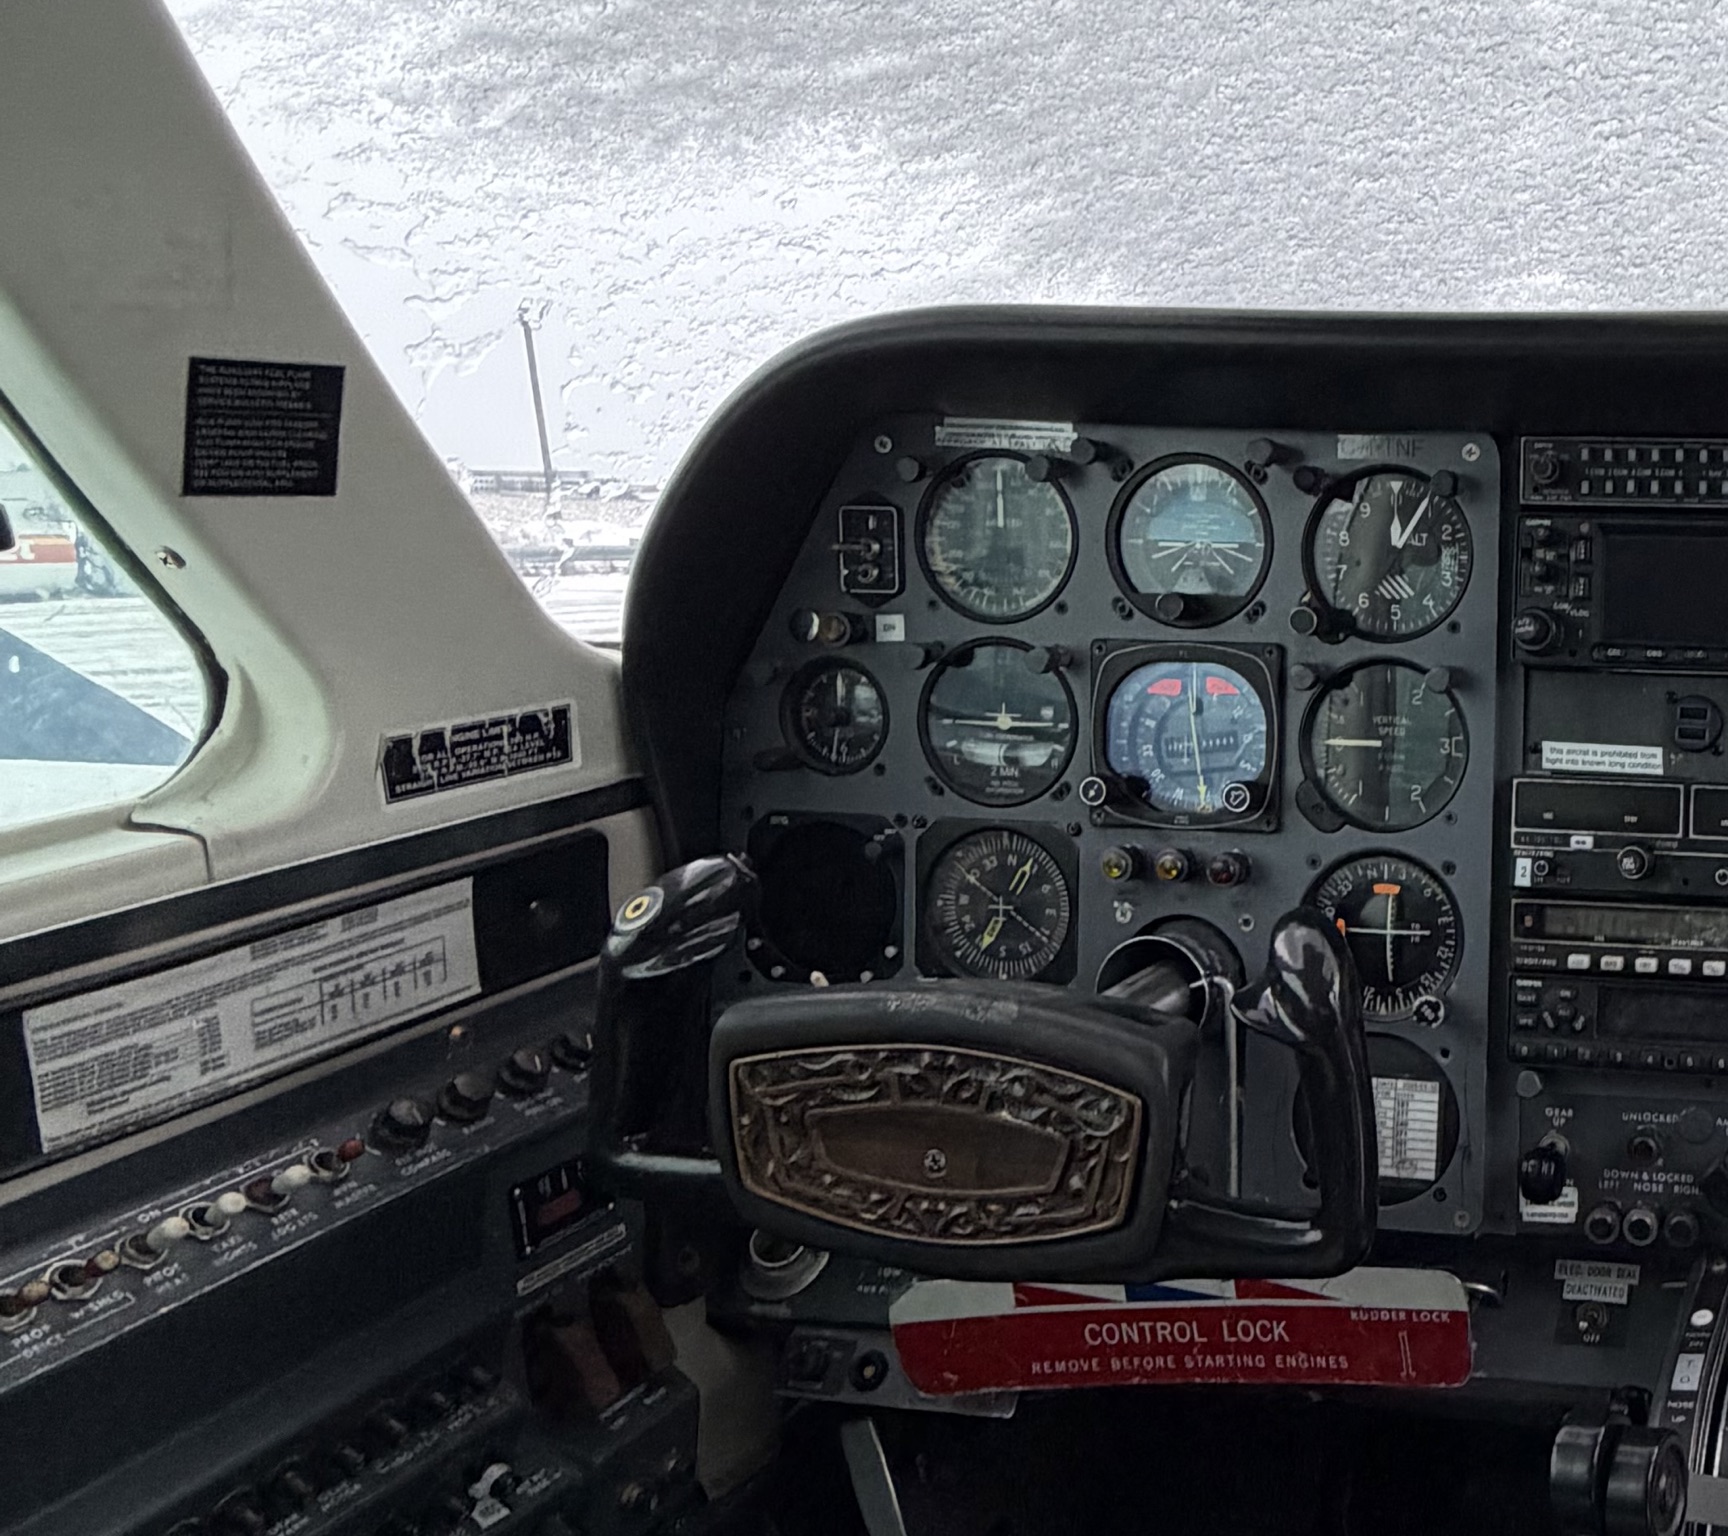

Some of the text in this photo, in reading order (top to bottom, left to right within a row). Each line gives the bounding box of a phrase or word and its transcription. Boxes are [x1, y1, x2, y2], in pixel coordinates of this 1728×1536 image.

[1359, 502, 1371, 518] 9
[1441, 524, 1452, 541] 2
[1358, 592, 1369, 608] 6
[1422, 593, 1435, 608] 4
[1391, 604, 1401, 620] 5
[1411, 689, 1423, 705] 2
[1439, 738, 1451, 754] 3
[990, 766, 998, 776] 2
[1411, 785, 1422, 801] 2
[1007, 854, 1017, 866] N
[1520, 866, 1527, 878] 2
[1552, 1118, 1566, 1127] UP
[1622, 1112, 1680, 1124] UNLOCKED
[1604, 1168, 1694, 1183] DOWN LOCKED
[1634, 1182, 1664, 1193] NOSE
[1566, 1284, 1625, 1298] DEACTIVATED
[1412, 1311, 1450, 1323] LOCK
[1084, 1319, 1289, 1346] CONTROL LOCK
[1031, 1354, 1348, 1374] REMOVE BEFORE STARTING ENGINES
